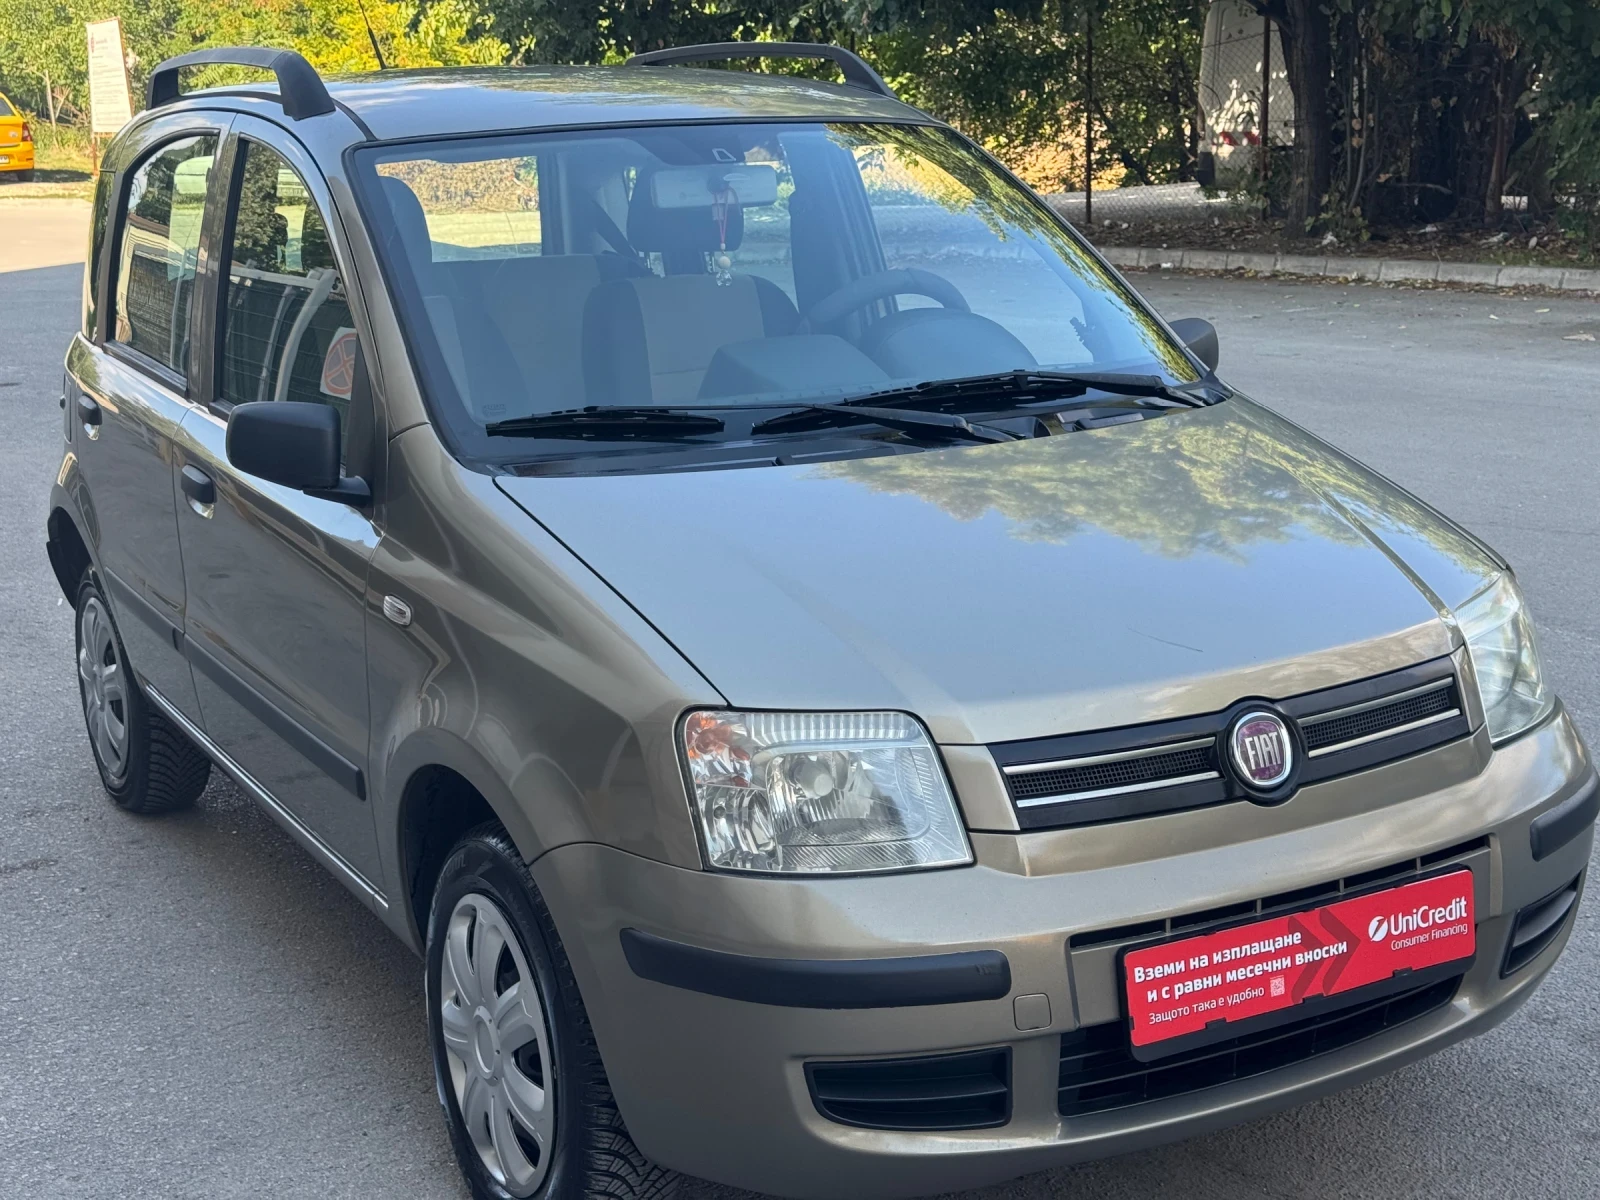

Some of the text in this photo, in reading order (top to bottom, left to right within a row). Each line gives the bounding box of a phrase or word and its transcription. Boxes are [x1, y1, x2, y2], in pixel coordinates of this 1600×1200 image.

[1244, 731, 1282, 770] FIAT
[1390, 895, 1467, 936] UniCredit
[1133, 931, 1302, 983] Вземи на изплащане
[1390, 923, 1468, 951] Consumer Financing
[1147, 941, 1347, 1003] и с равни месечни вноски
[1148, 987, 1265, 1025] Защото така е удобно
